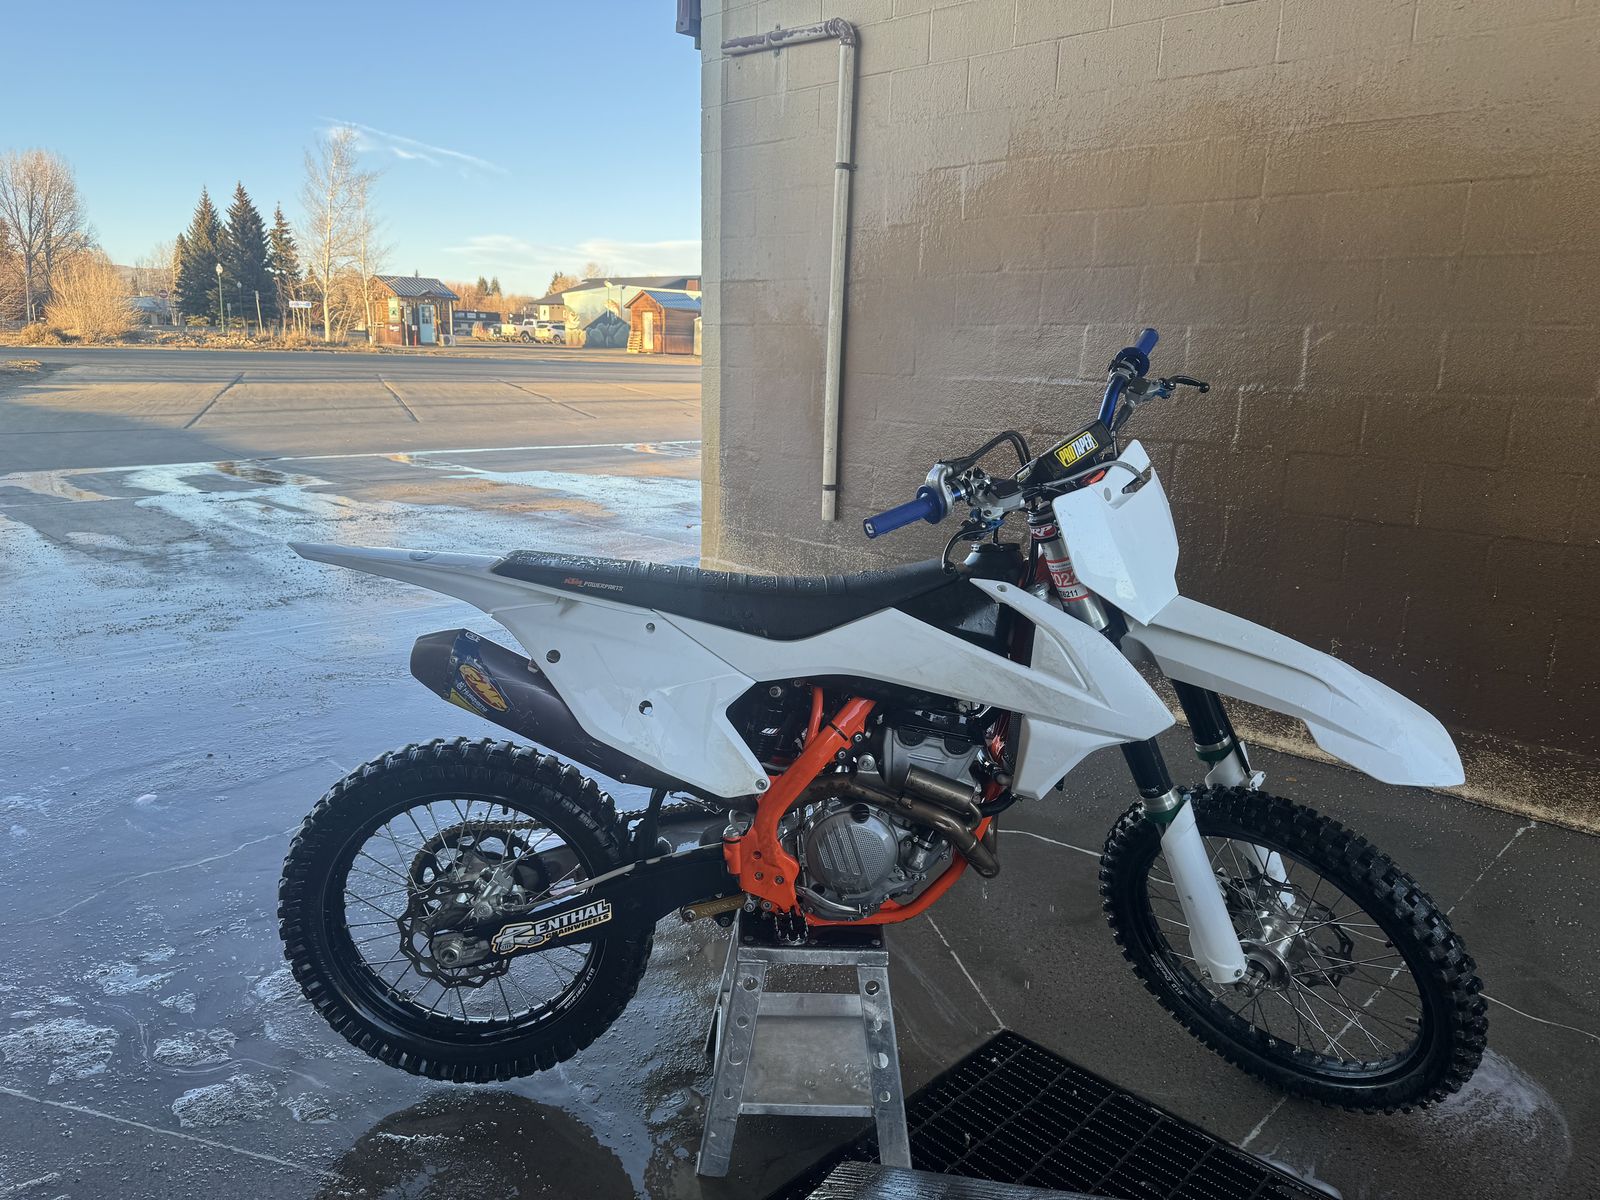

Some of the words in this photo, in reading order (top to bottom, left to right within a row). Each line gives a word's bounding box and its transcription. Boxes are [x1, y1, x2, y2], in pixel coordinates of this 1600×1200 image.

[1058, 433, 1095, 465] PROTAPER
[583, 581, 624, 592] POWERPARTS
[461, 666, 508, 710] FMF
[463, 686, 489, 712] Husqvarna
[494, 903, 609, 951] RENTHAL
[545, 913, 610, 939] CHAINWHEELS
